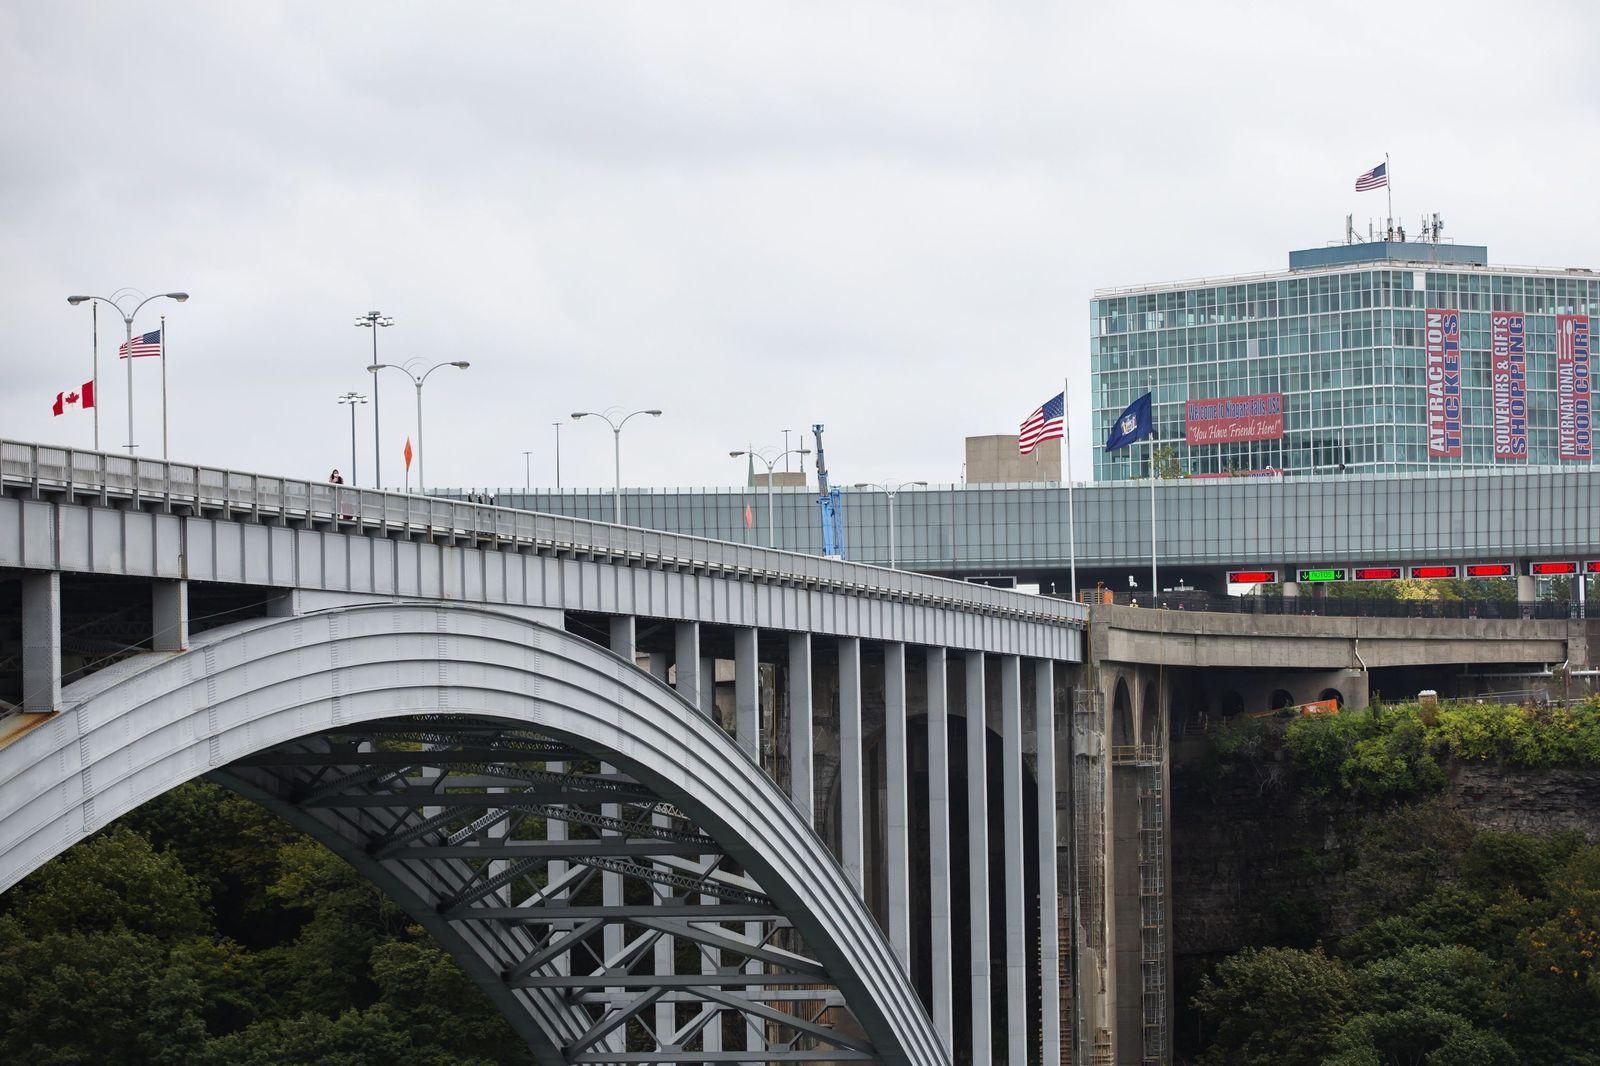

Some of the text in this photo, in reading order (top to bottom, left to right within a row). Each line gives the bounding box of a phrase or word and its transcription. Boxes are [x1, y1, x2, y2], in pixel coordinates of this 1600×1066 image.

[1188, 404, 1217, 421] Welcome
[1218, 403, 1224, 419] to
[1225, 400, 1249, 419] Niagara
[1267, 397, 1280, 415] USA
[1208, 424, 1228, 439] Have
[1228, 419, 1255, 437] Friends
[1428, 314, 1444, 452] ATTRACTION
[1443, 314, 1460, 453] TICKETS
[1494, 317, 1510, 453] SOUVENIRS & GIFTS
[1509, 316, 1526, 454] SHOPPING
[1560, 362, 1575, 455] INTERNATIONAL
[1574, 319, 1591, 456] FOOD COURT
